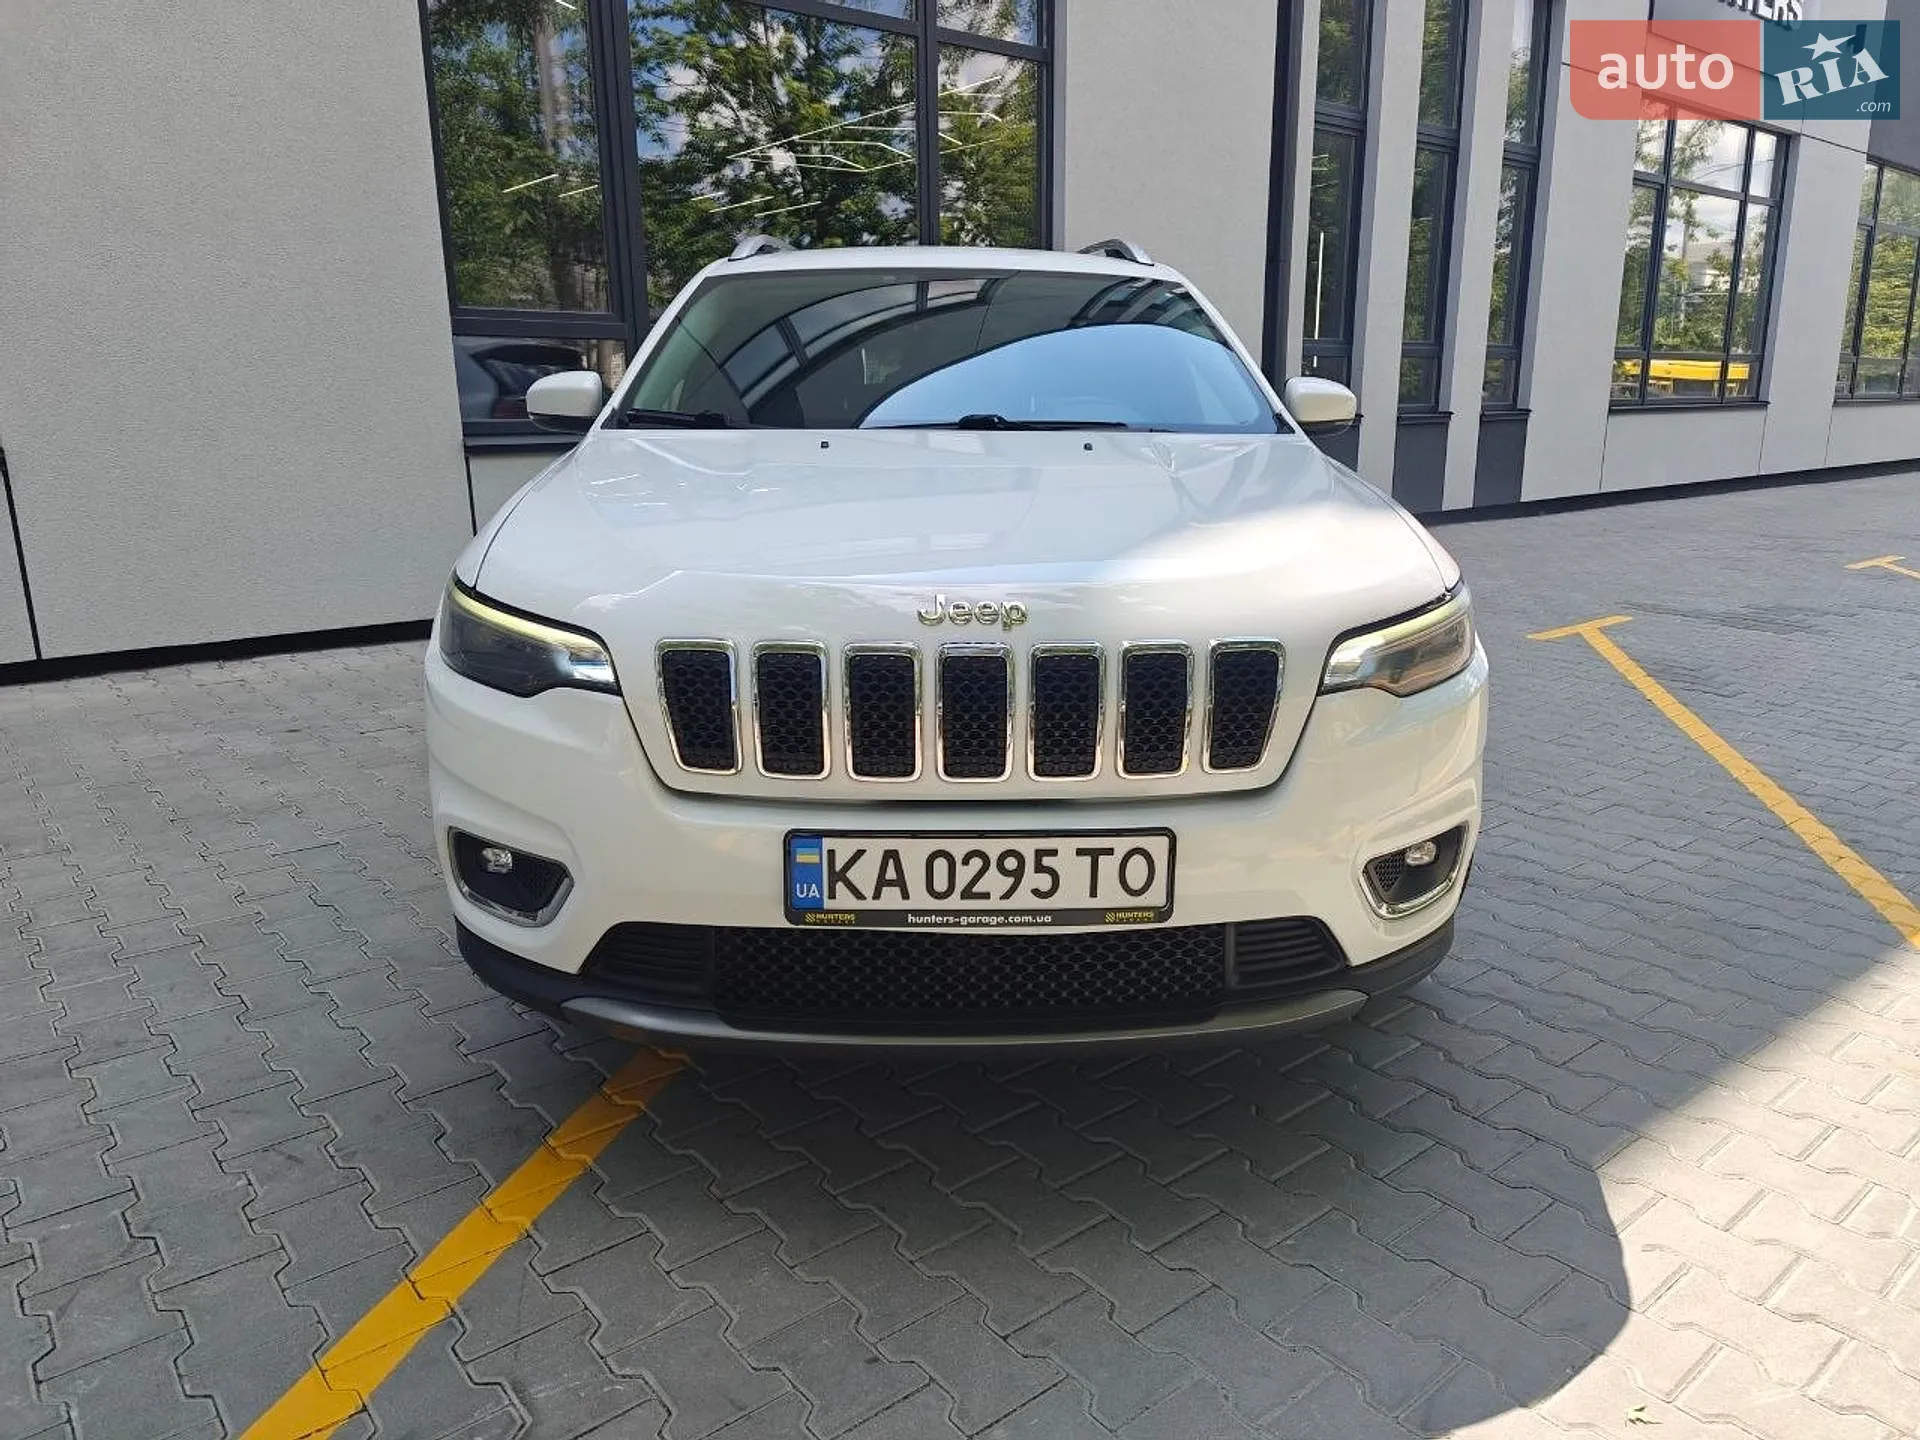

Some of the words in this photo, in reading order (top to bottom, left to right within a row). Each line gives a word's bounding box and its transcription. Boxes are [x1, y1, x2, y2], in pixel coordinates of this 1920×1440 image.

[917, 594, 1028, 631] Jeep
[827, 848, 910, 900] KA
[925, 849, 1061, 900] 0295
[1075, 847, 1156, 898] TO
[796, 883, 820, 898] UA
[907, 913, 1052, 925] hunters-garage.com.ua
